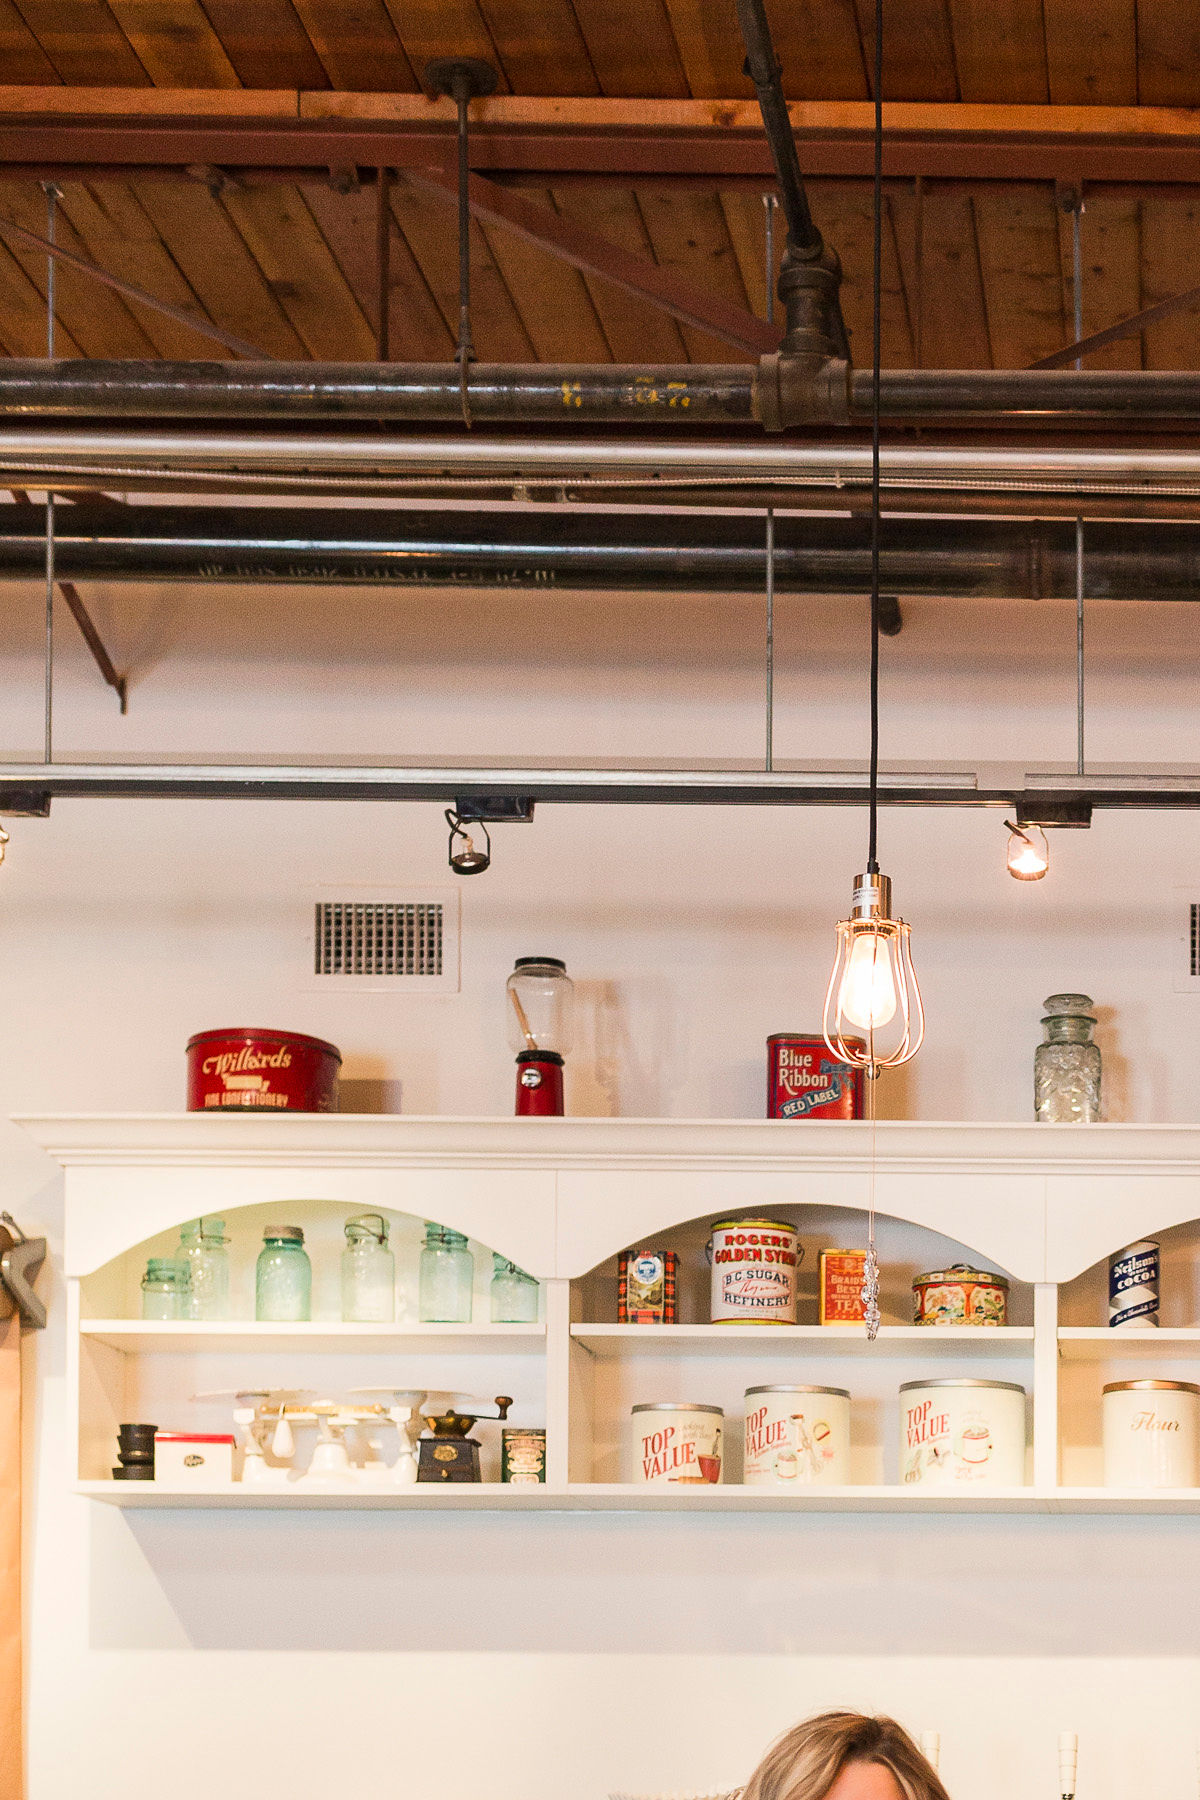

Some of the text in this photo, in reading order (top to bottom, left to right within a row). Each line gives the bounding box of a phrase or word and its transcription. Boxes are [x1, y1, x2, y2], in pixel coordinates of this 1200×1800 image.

[779, 1048, 813, 1067] Blue
[779, 1068, 828, 1095] Ribbon
[783, 1089, 839, 1116] RED LABEL
[715, 1248, 762, 1264] GOLDEN
[746, 1270, 789, 1287] SUGAR
[836, 1284, 861, 1294] BEST
[1117, 1269, 1156, 1290] COCOA
[724, 1293, 790, 1306] REFINERY
[834, 1300, 862, 1313] TEA
[907, 1400, 932, 1429] TOP
[1130, 1411, 1183, 1433] Flour
[907, 1413, 950, 1449] VALUE
[642, 1426, 676, 1459] TOP
[642, 1442, 697, 1481] VALUE
